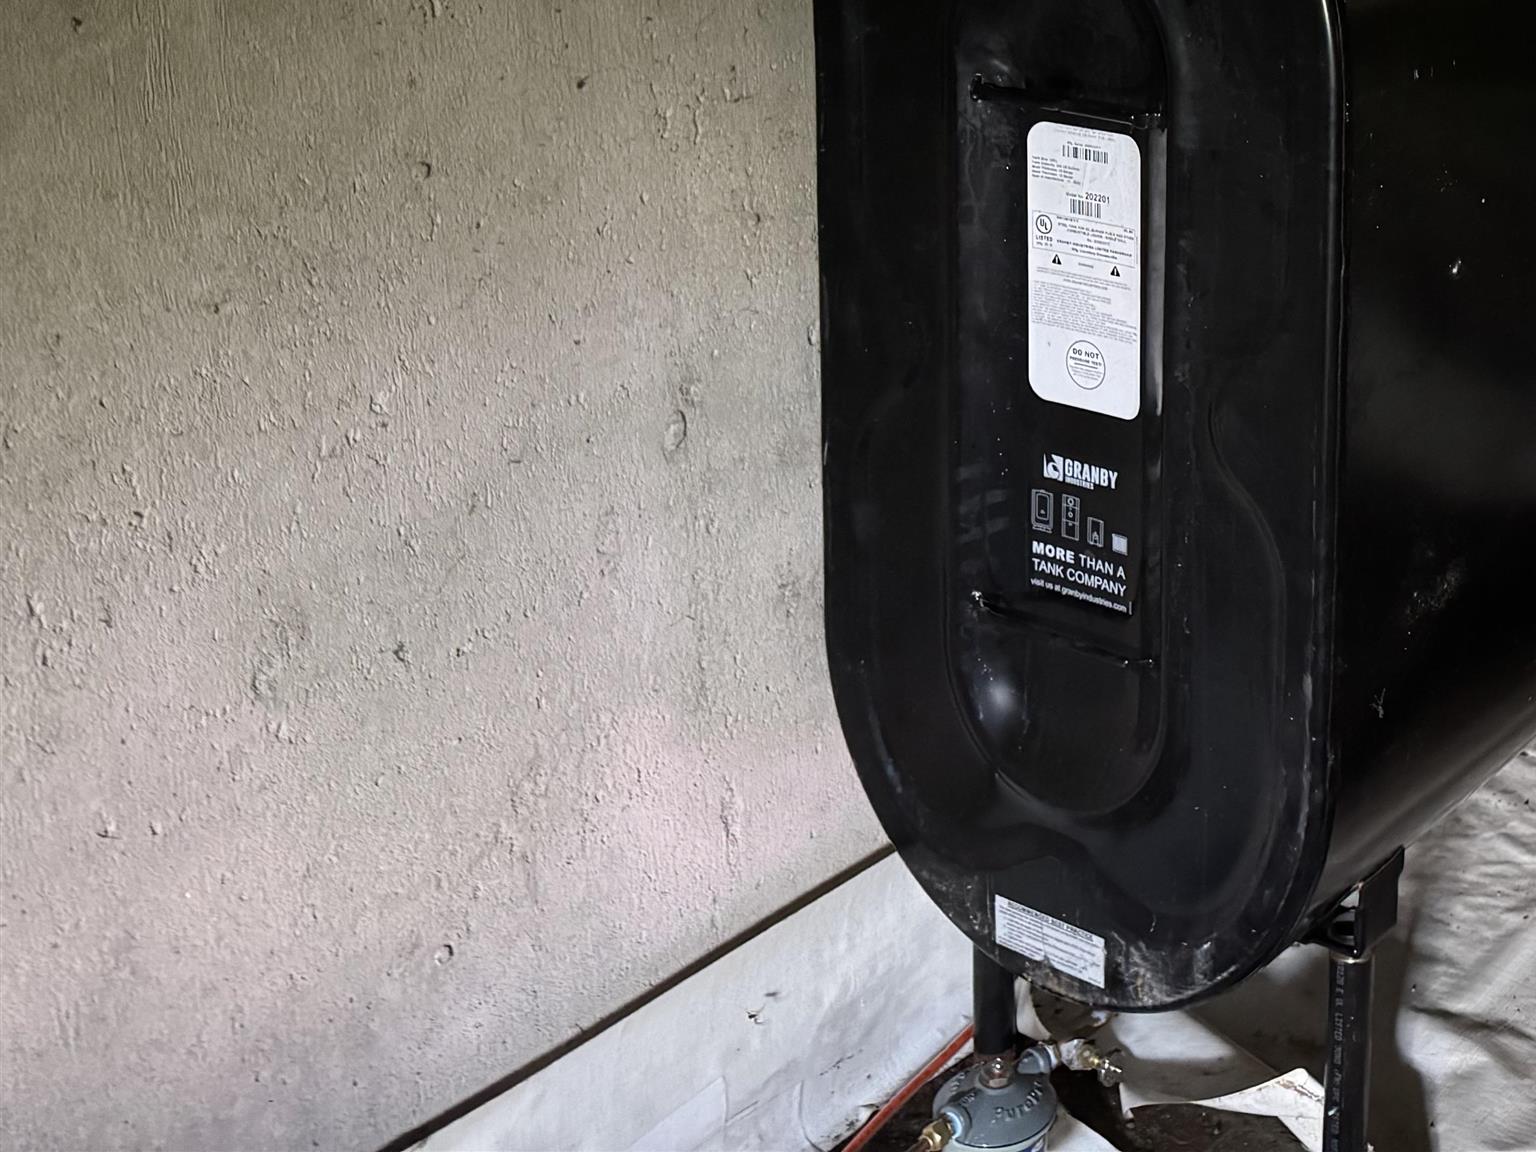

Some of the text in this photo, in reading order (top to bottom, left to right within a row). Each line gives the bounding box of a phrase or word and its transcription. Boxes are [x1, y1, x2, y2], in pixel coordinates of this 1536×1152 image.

[1085, 192, 1110, 204] 202201
[1040, 218, 1048, 231] UL
[1072, 348, 1099, 359] DO NOT
[1065, 458, 1118, 489] GRANBY
[1032, 540, 1126, 580] MORE THAN A
[1030, 577, 1044, 588] visit
[1045, 582, 1053, 590] us
[1054, 584, 1061, 592] at
[1032, 558, 1127, 597] TANK COMPANY
